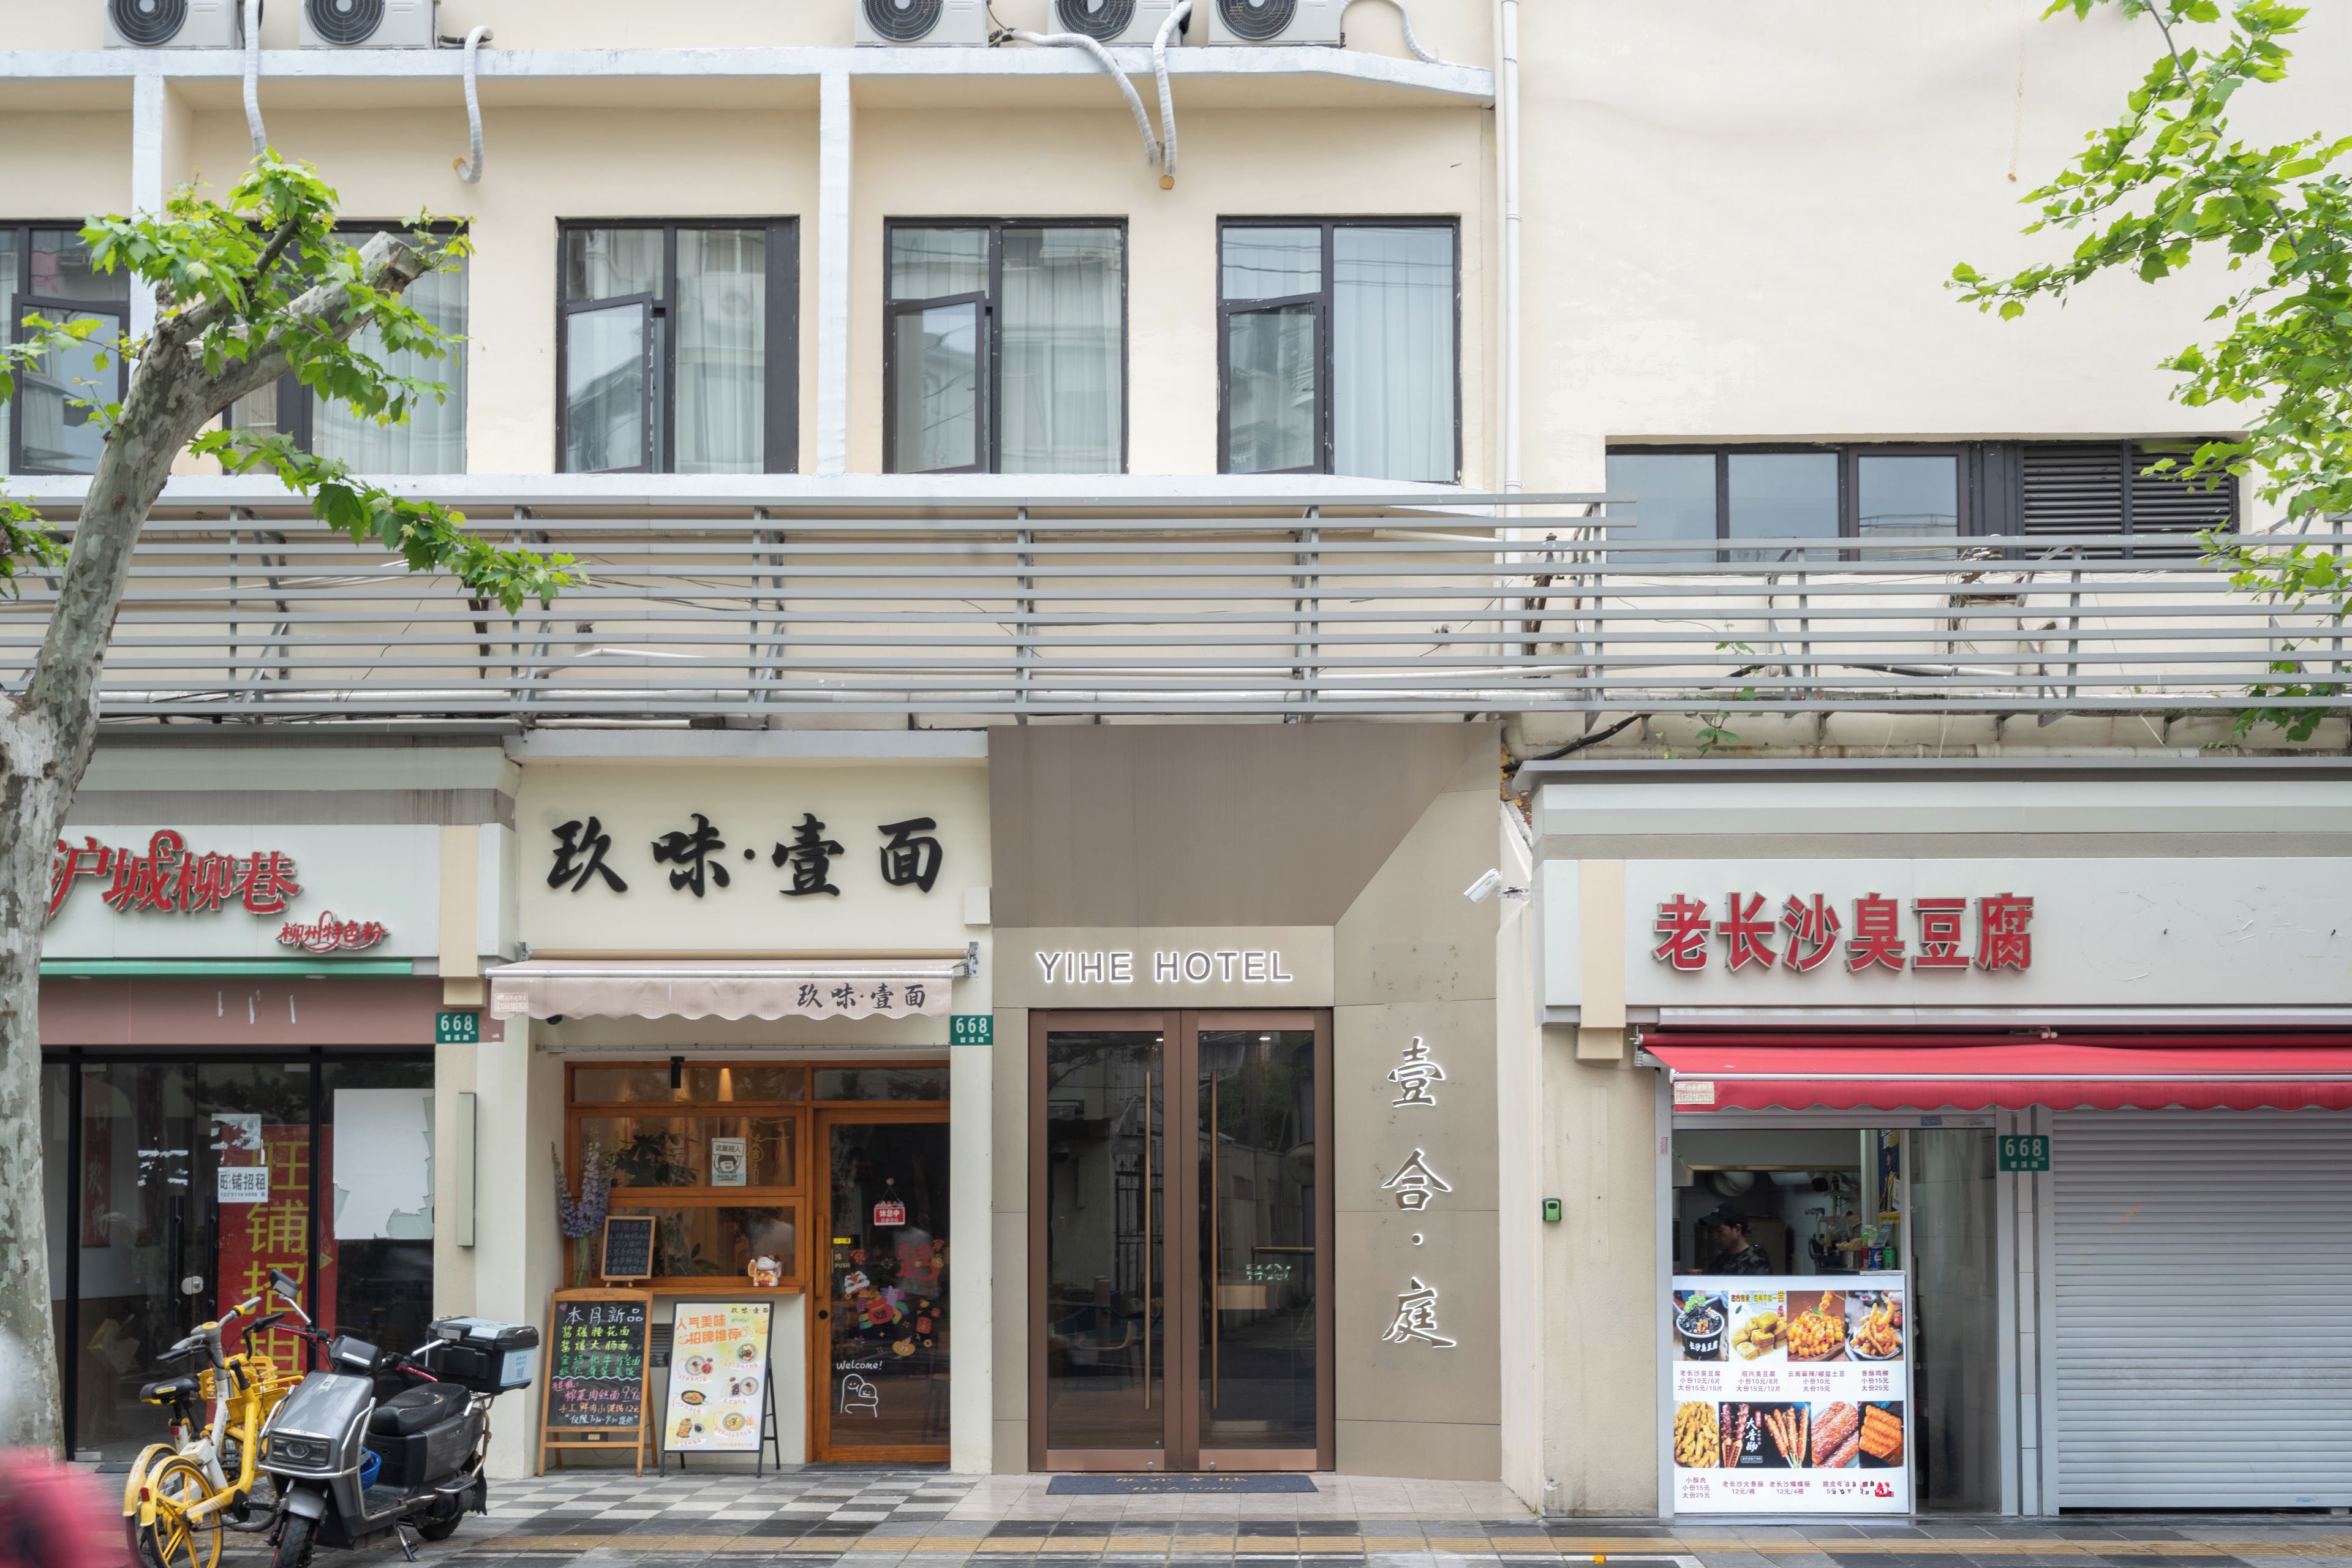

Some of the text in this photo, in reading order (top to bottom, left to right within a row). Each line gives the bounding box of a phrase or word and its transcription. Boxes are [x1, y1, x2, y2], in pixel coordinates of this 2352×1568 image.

[546, 813, 943, 898] 玖味·壹面
[48, 829, 304, 918] 沪城柳巷
[276, 911, 389, 952] 柳州特色粉
[1652, 892, 2034, 972] 老长沙臭豆腐
[1035, 950, 1293, 984] YIHE HOTEL
[797, 983, 925, 1009] 玖味·壹面
[441, 1015, 472, 1031] 668
[956, 1017, 987, 1033] 668
[2005, 1138, 2041, 1157] 668
[1382, 1036, 1457, 1348] 壹合·庭
[879, 1209, 900, 1218] 休息中
[565, 1306, 643, 1325] 本月新品
[676, 1314, 726, 1331] 人气美味
[562, 1325, 630, 1338] 酱爆腰花面
[688, 1327, 743, 1345] 招牌推荐
[560, 1339, 628, 1352] 酱爆大肠面
[836, 1360, 883, 1370] Welcome!
[1745, 1417, 1758, 1452] 大香肠
